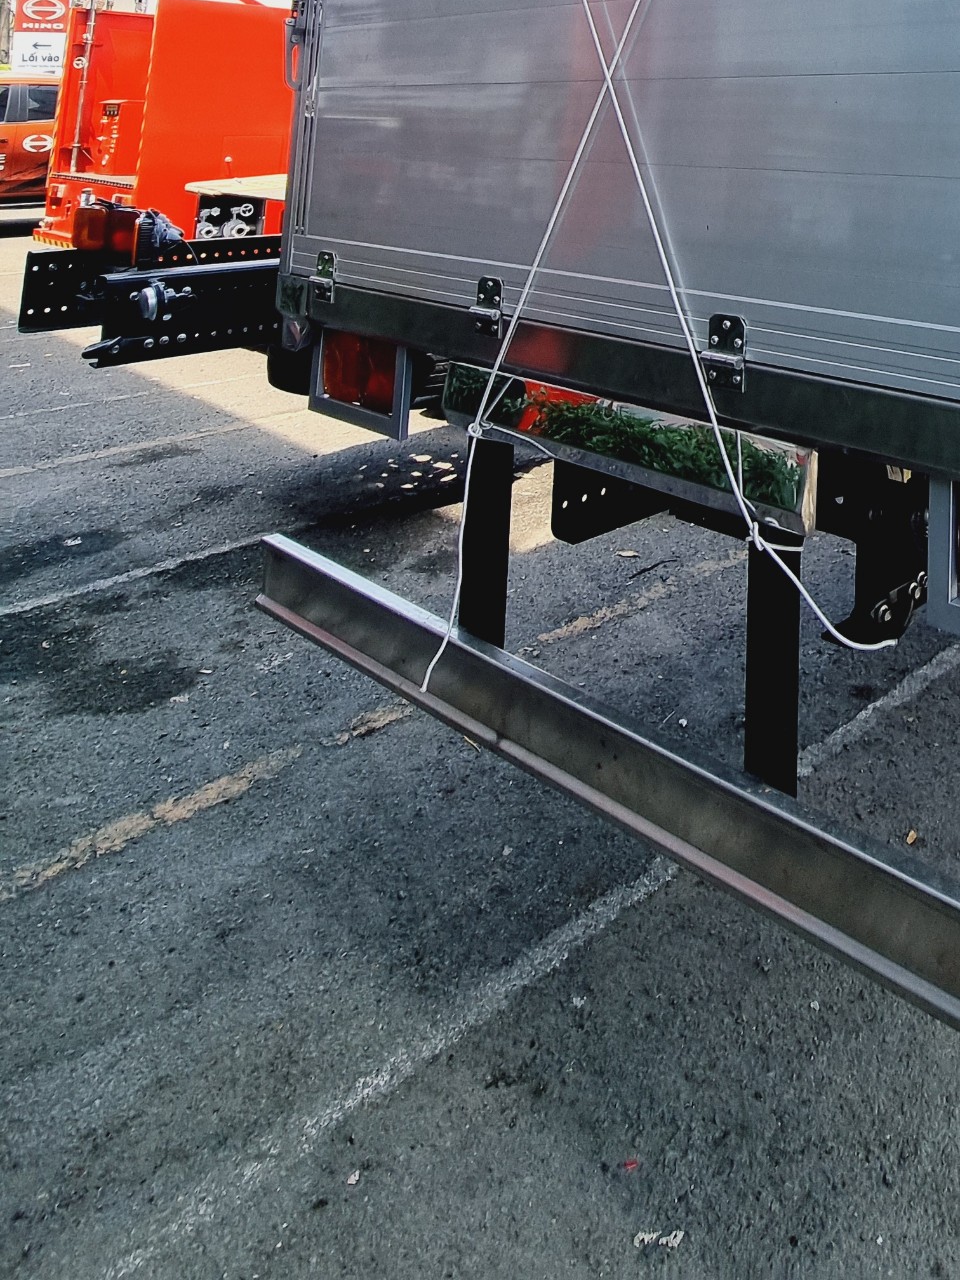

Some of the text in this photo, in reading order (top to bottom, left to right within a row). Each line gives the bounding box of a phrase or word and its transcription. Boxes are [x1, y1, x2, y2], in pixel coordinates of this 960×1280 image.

[22, 22, 64, 30] HINO
[22, 52, 60, 62] Lối vào
